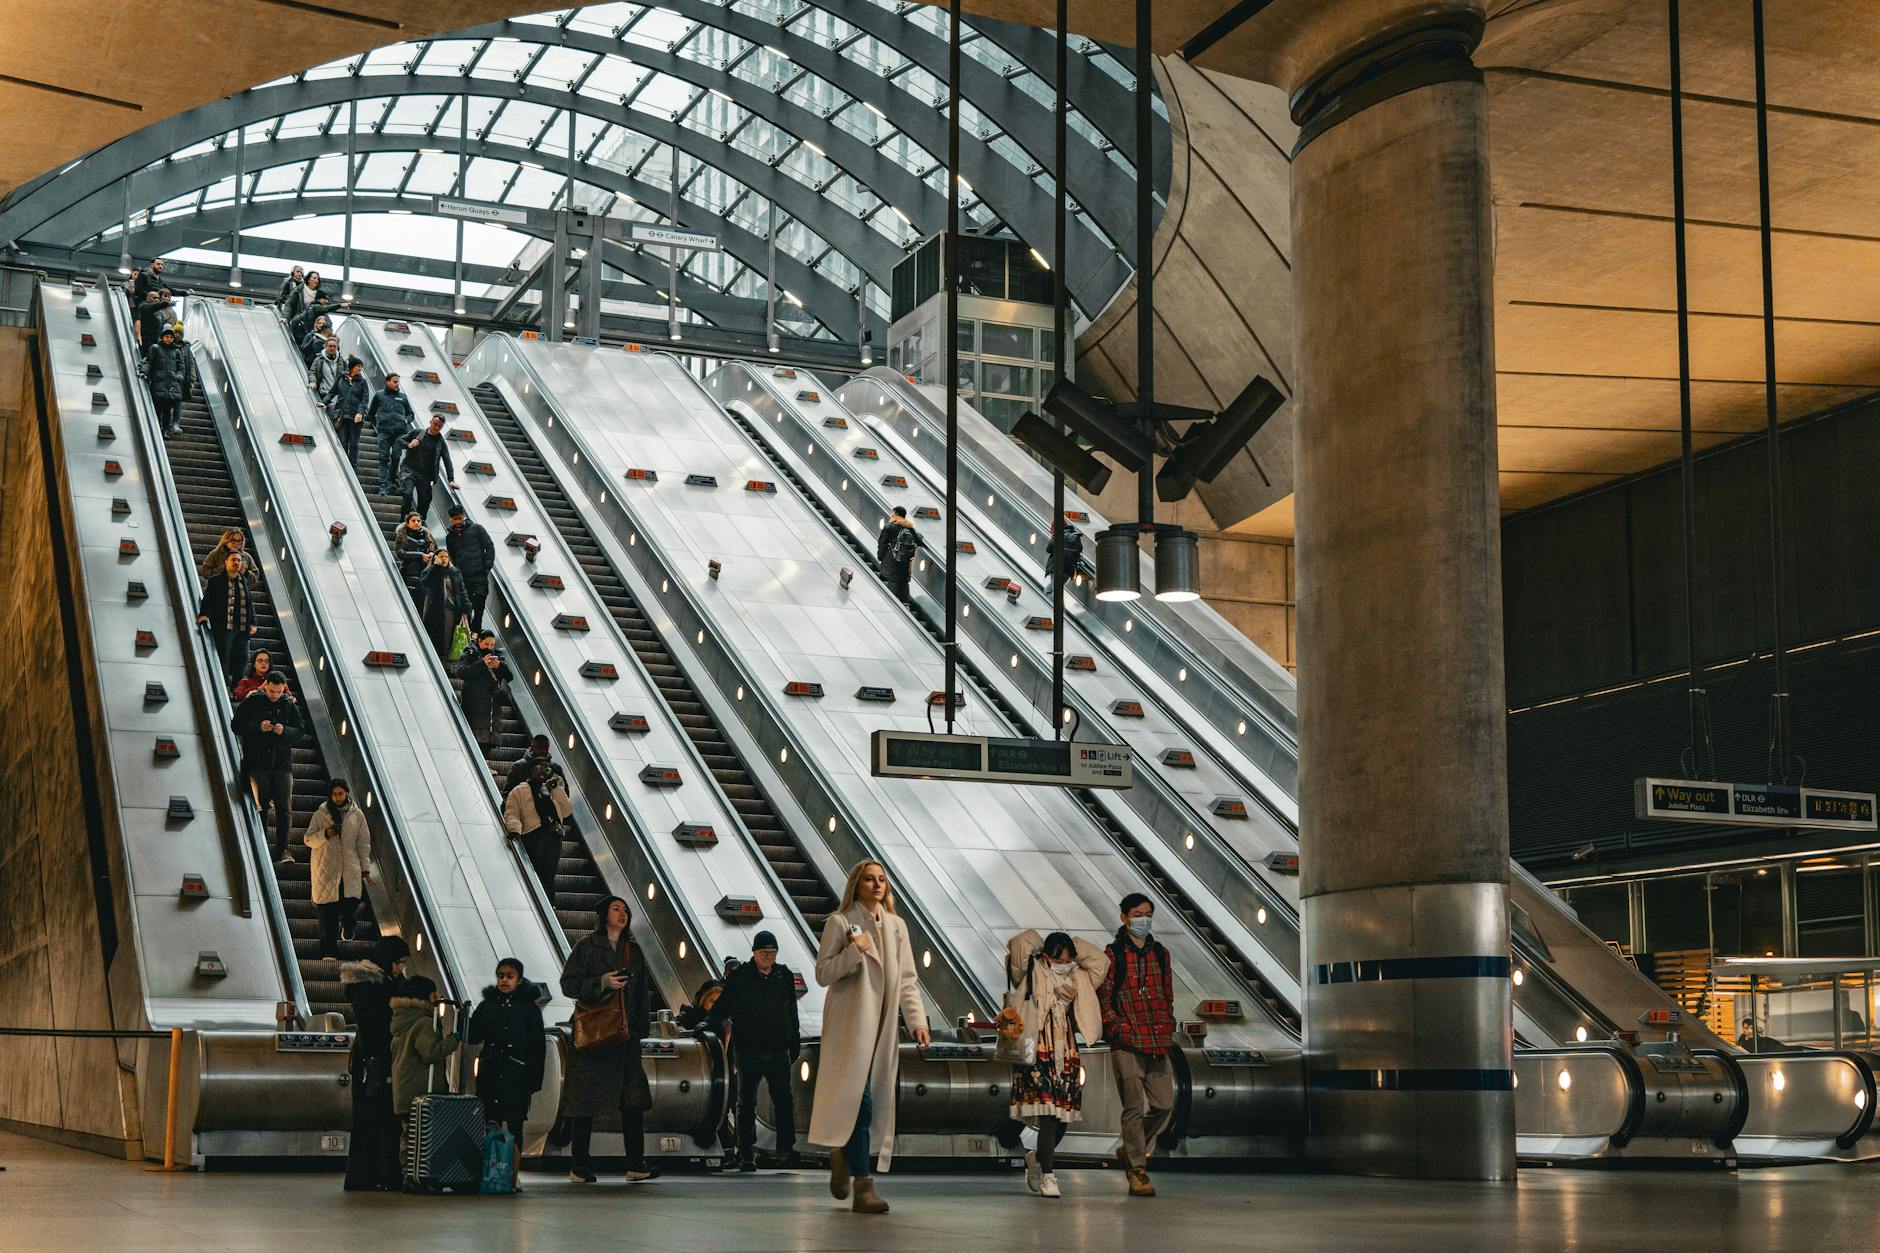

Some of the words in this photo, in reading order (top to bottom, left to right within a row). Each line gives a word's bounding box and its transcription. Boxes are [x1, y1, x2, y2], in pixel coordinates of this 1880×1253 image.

[447, 204, 468, 212] Heron
[469, 207, 490, 216] Quays
[666, 233, 687, 242] Canary
[689, 236, 708, 244] Wharf
[1107, 752, 1122, 760] Lift
[1667, 788, 1692, 803] Way
[1695, 791, 1716, 802] out
[1742, 794, 1757, 802] DLR
[1668, 801, 1689, 810] Jubilee
[1690, 803, 1706, 811] Plaza
[1742, 804, 1776, 814] Elizabeth
[328, 1137, 338, 1147] 10
[667, 1138, 675, 1148] 11
